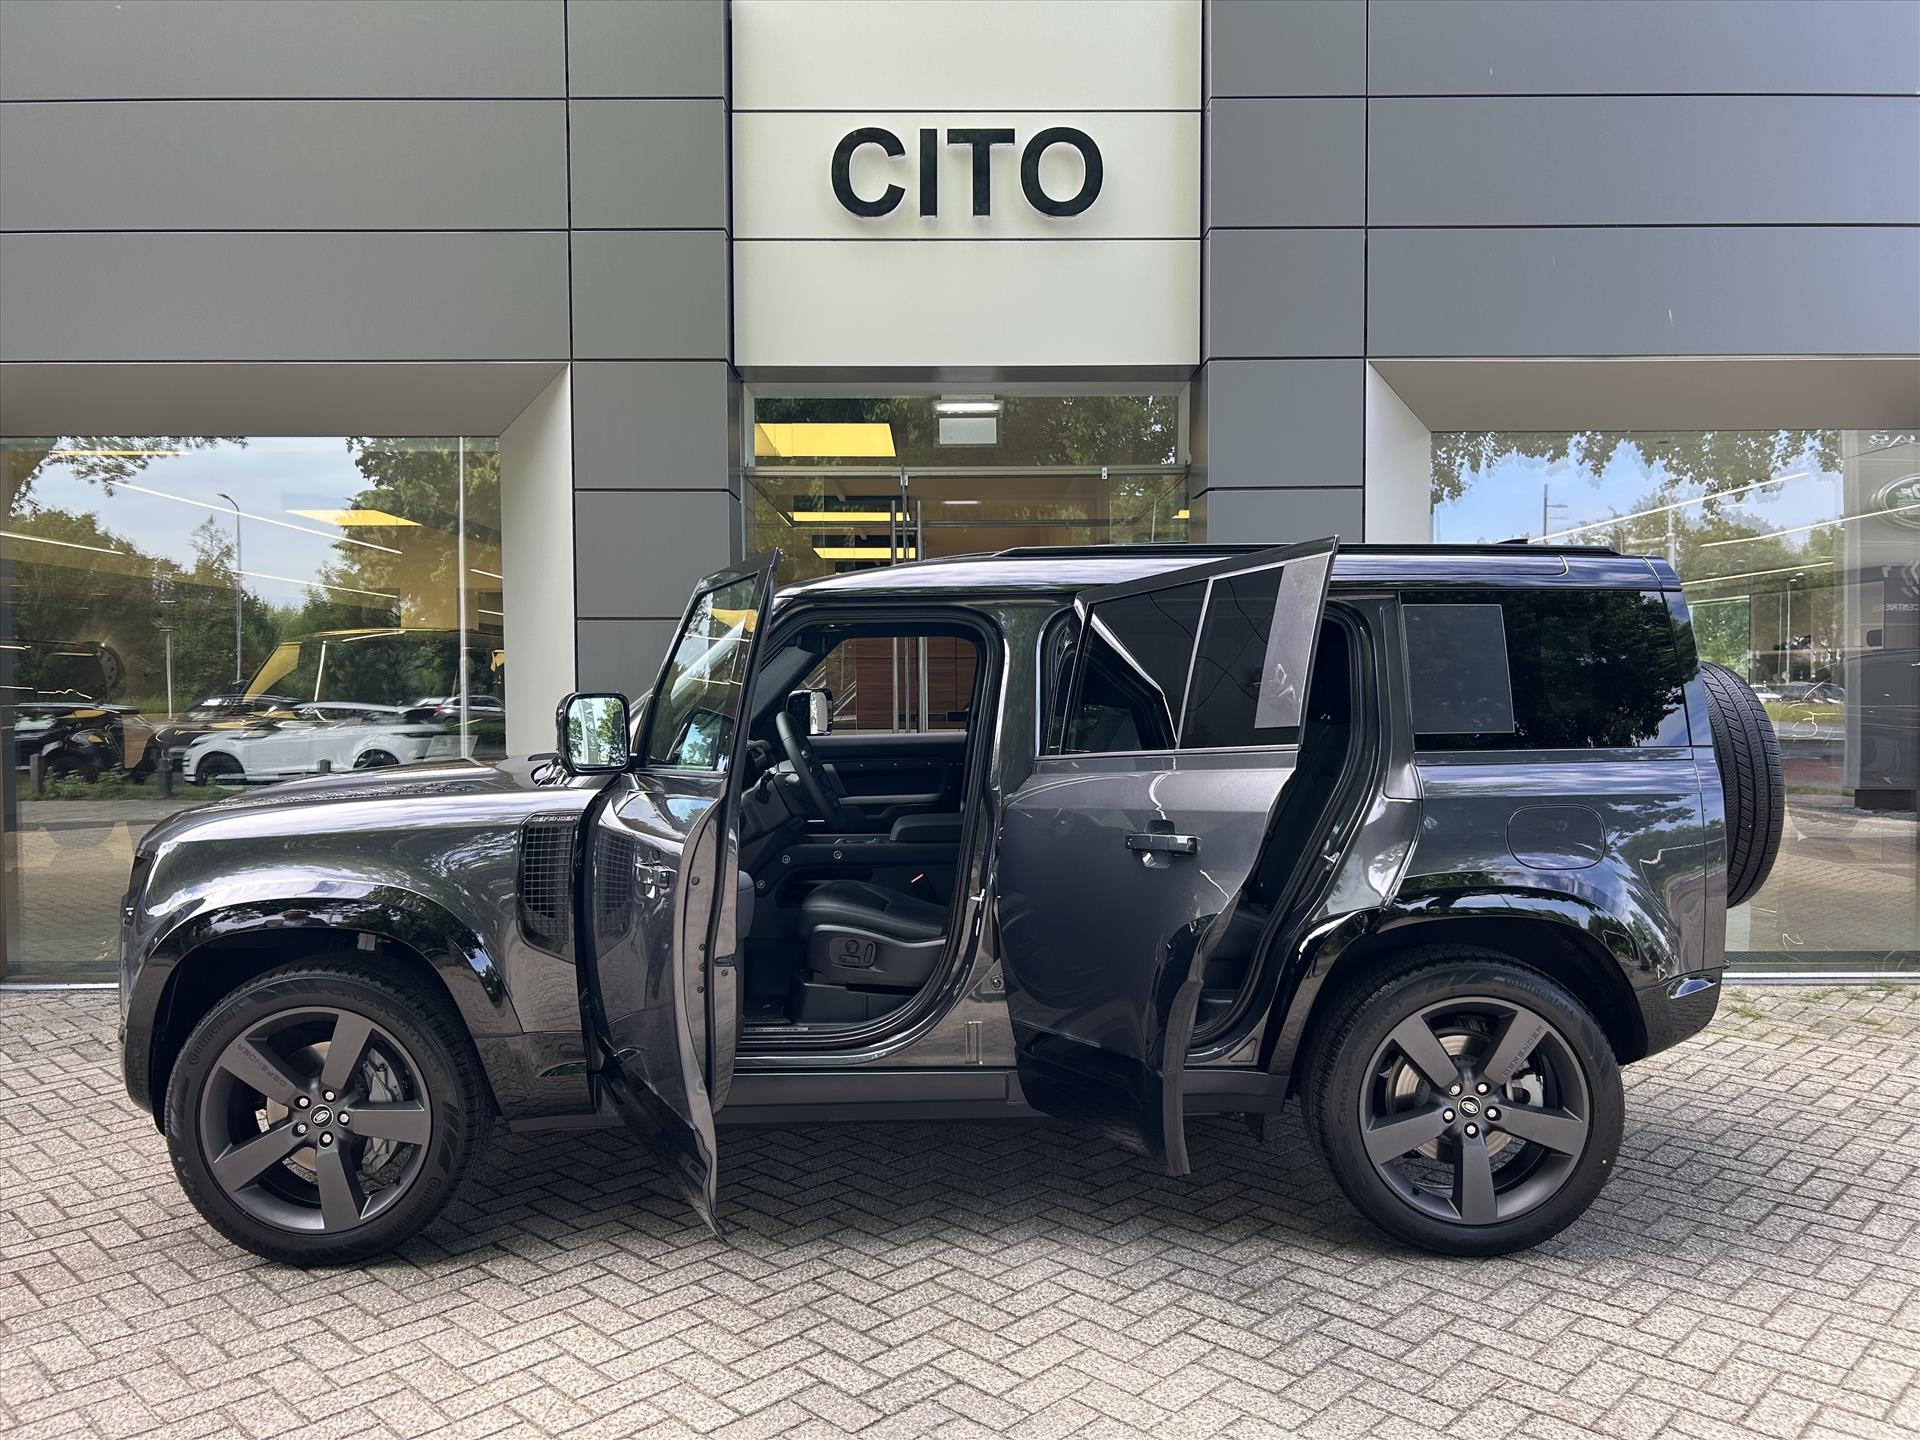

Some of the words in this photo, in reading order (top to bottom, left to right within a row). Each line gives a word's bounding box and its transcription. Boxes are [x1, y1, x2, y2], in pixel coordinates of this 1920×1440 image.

[831, 126, 1104, 217] CITO
[189, 1007, 237, 1065] Continental
[1502, 1024, 1545, 1077] DEFENDER
[237, 1042, 288, 1087] DEFENDER
